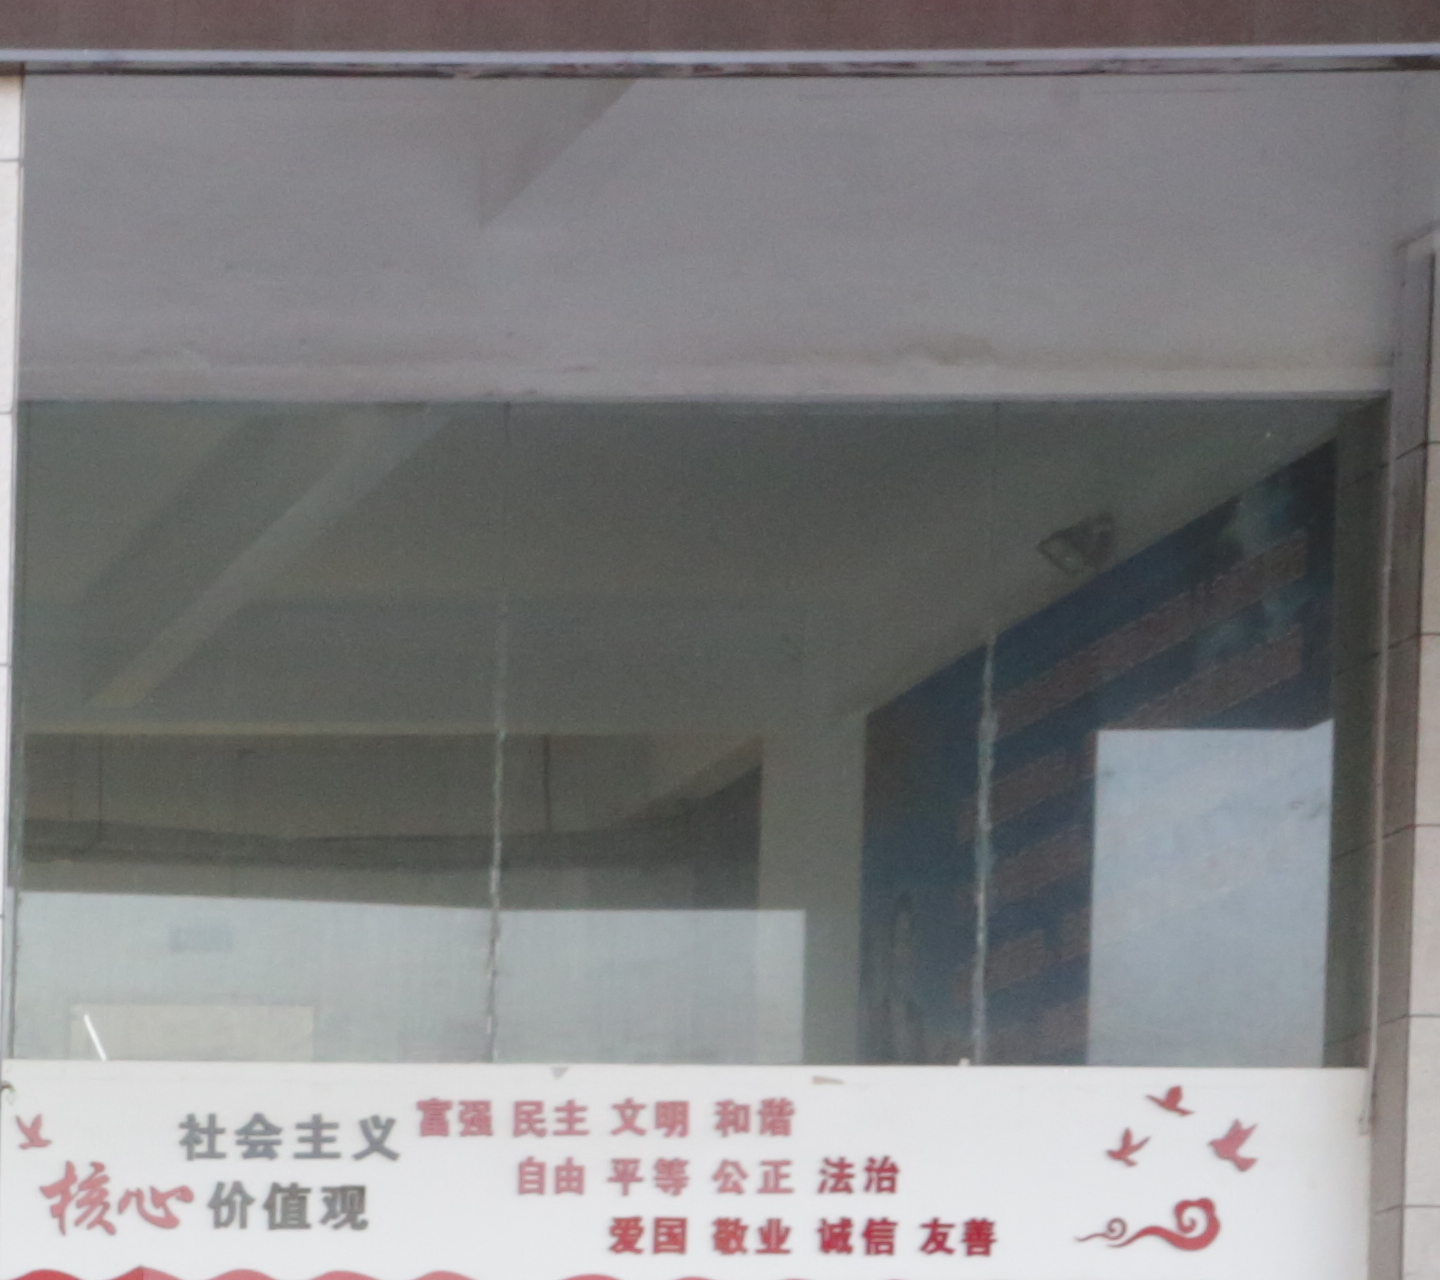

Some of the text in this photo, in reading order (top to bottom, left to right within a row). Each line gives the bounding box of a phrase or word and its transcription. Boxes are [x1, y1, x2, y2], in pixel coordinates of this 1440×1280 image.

[179, 1112, 401, 1161] 社会主义
[416, 1097, 795, 1138] 富强 民主 文明 和谐
[518, 1155, 899, 1196] 自由 平等 公正 法治
[609, 1216, 997, 1257] 爱国 敬业 诚信 友善
